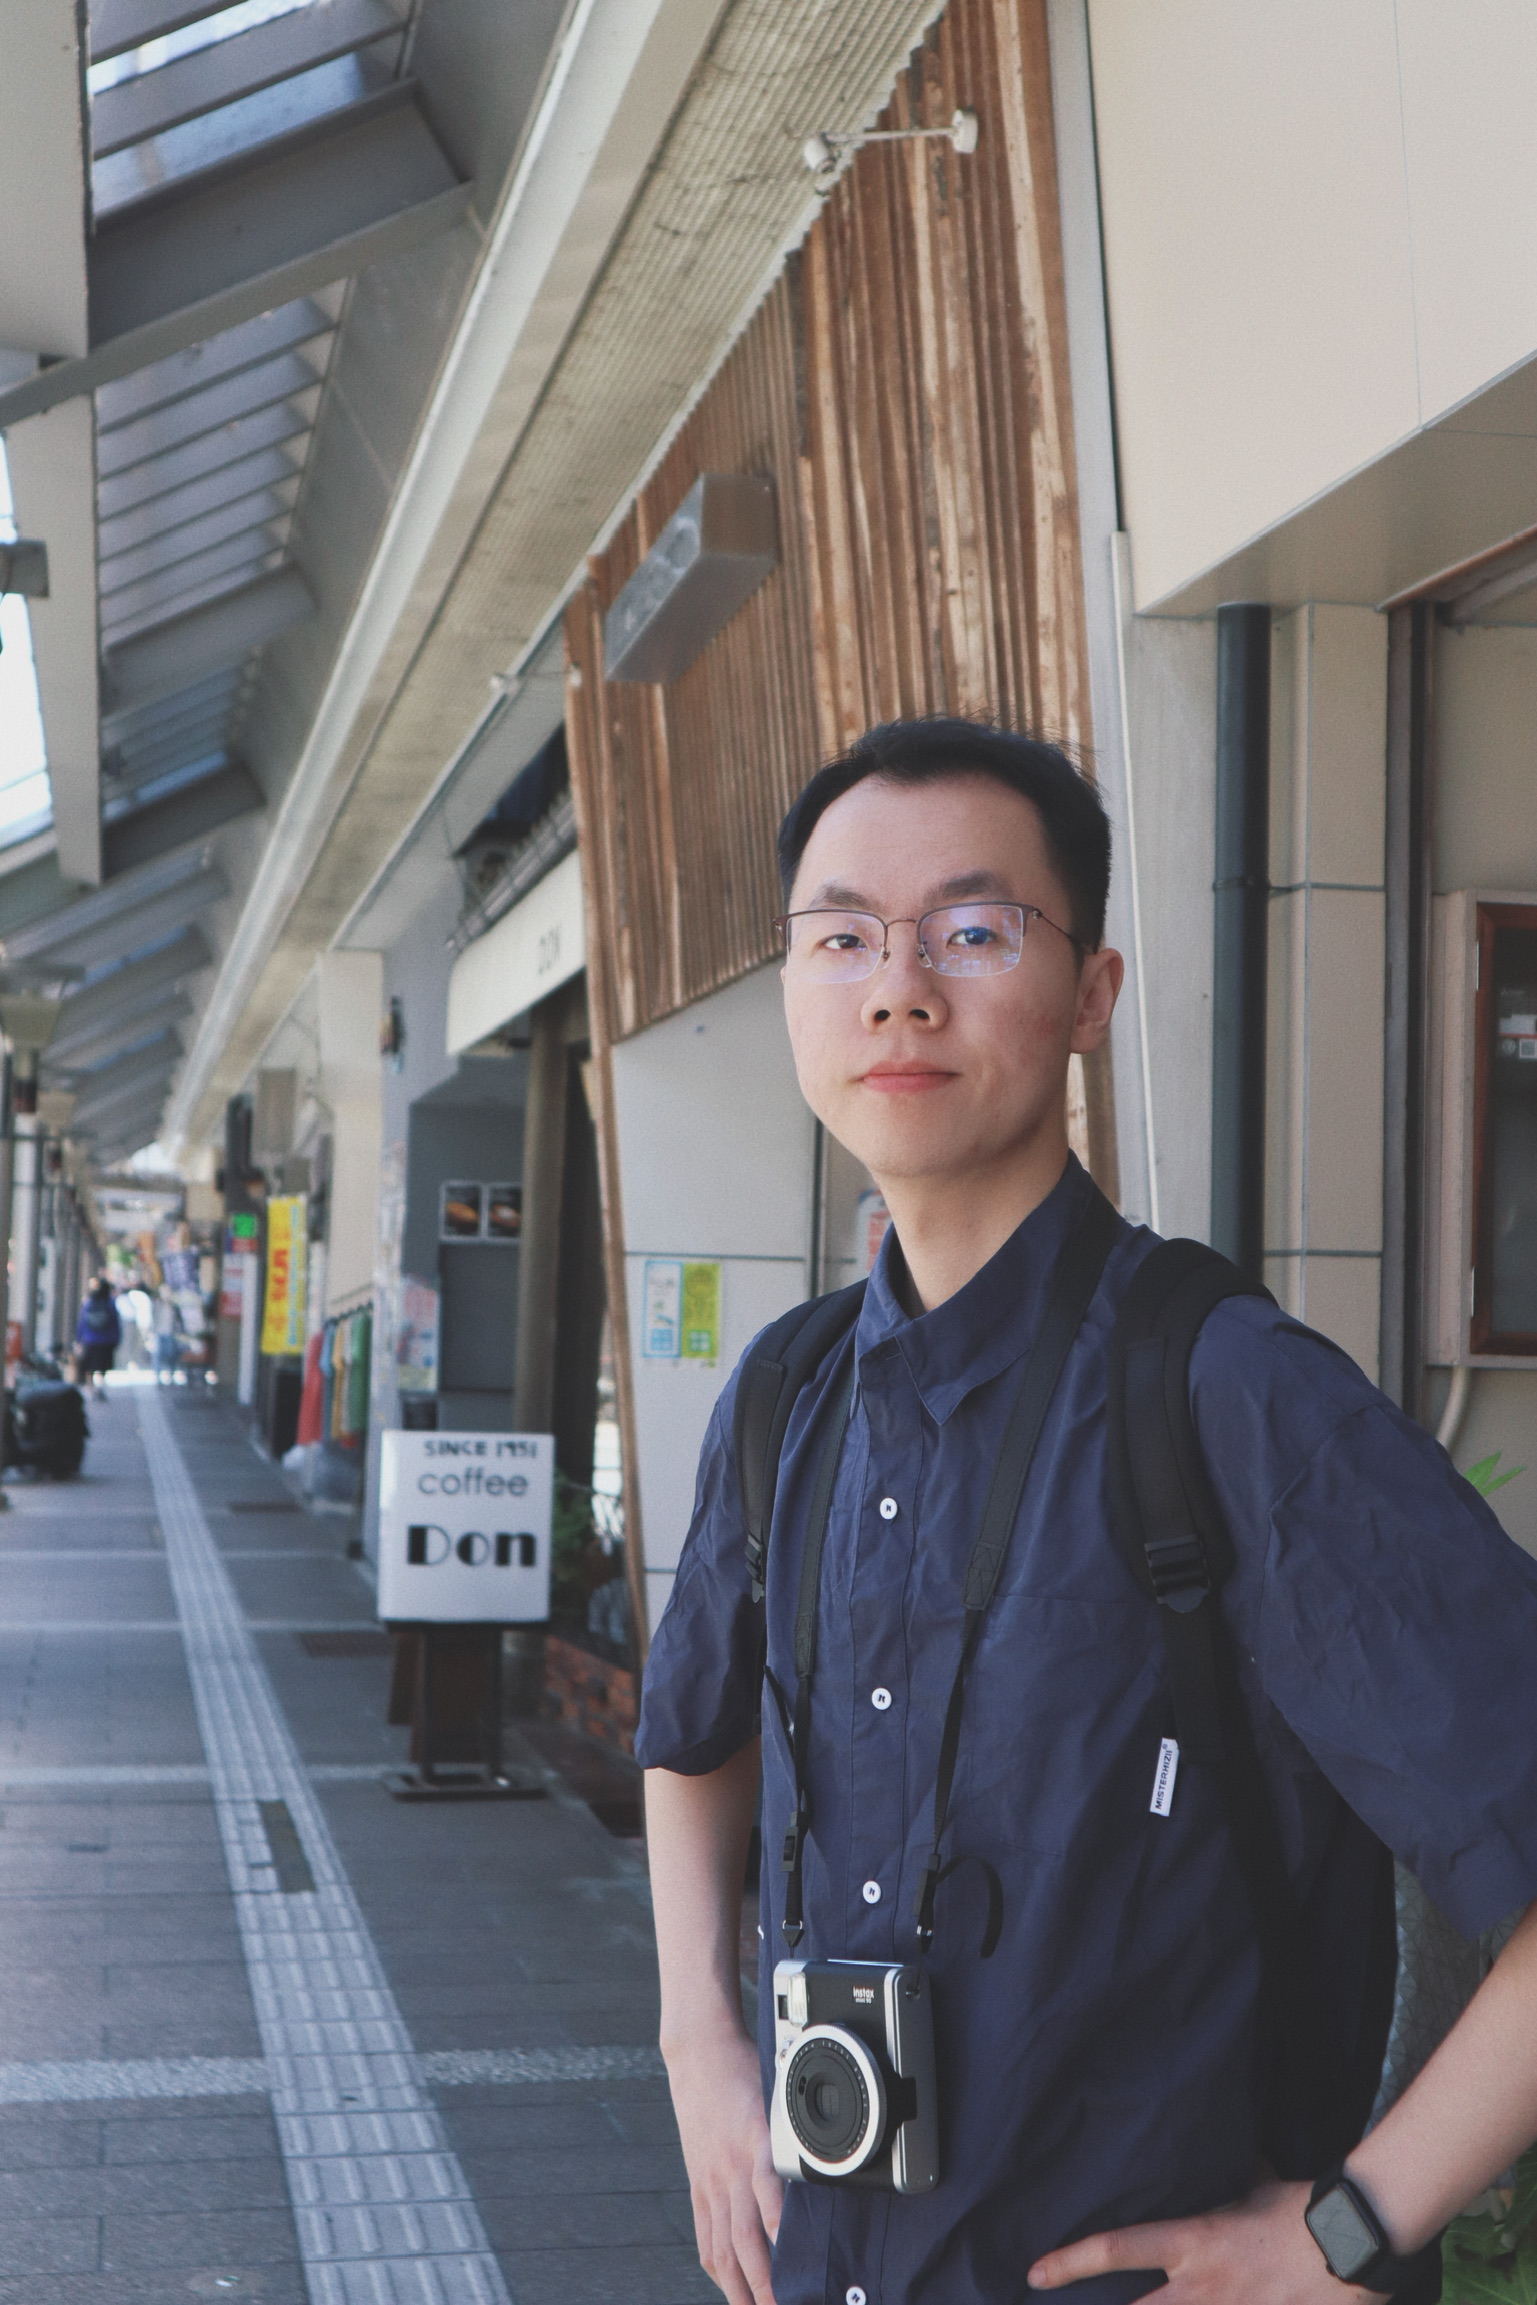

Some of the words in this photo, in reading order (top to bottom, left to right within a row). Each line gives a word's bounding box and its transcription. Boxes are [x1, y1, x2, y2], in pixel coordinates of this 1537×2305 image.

[424, 1439, 487, 1457] SINCE
[496, 1440, 538, 1459] 1951
[418, 1466, 528, 1496] coffee
[407, 1524, 537, 1567] Don
[853, 1986, 875, 1999] instax
